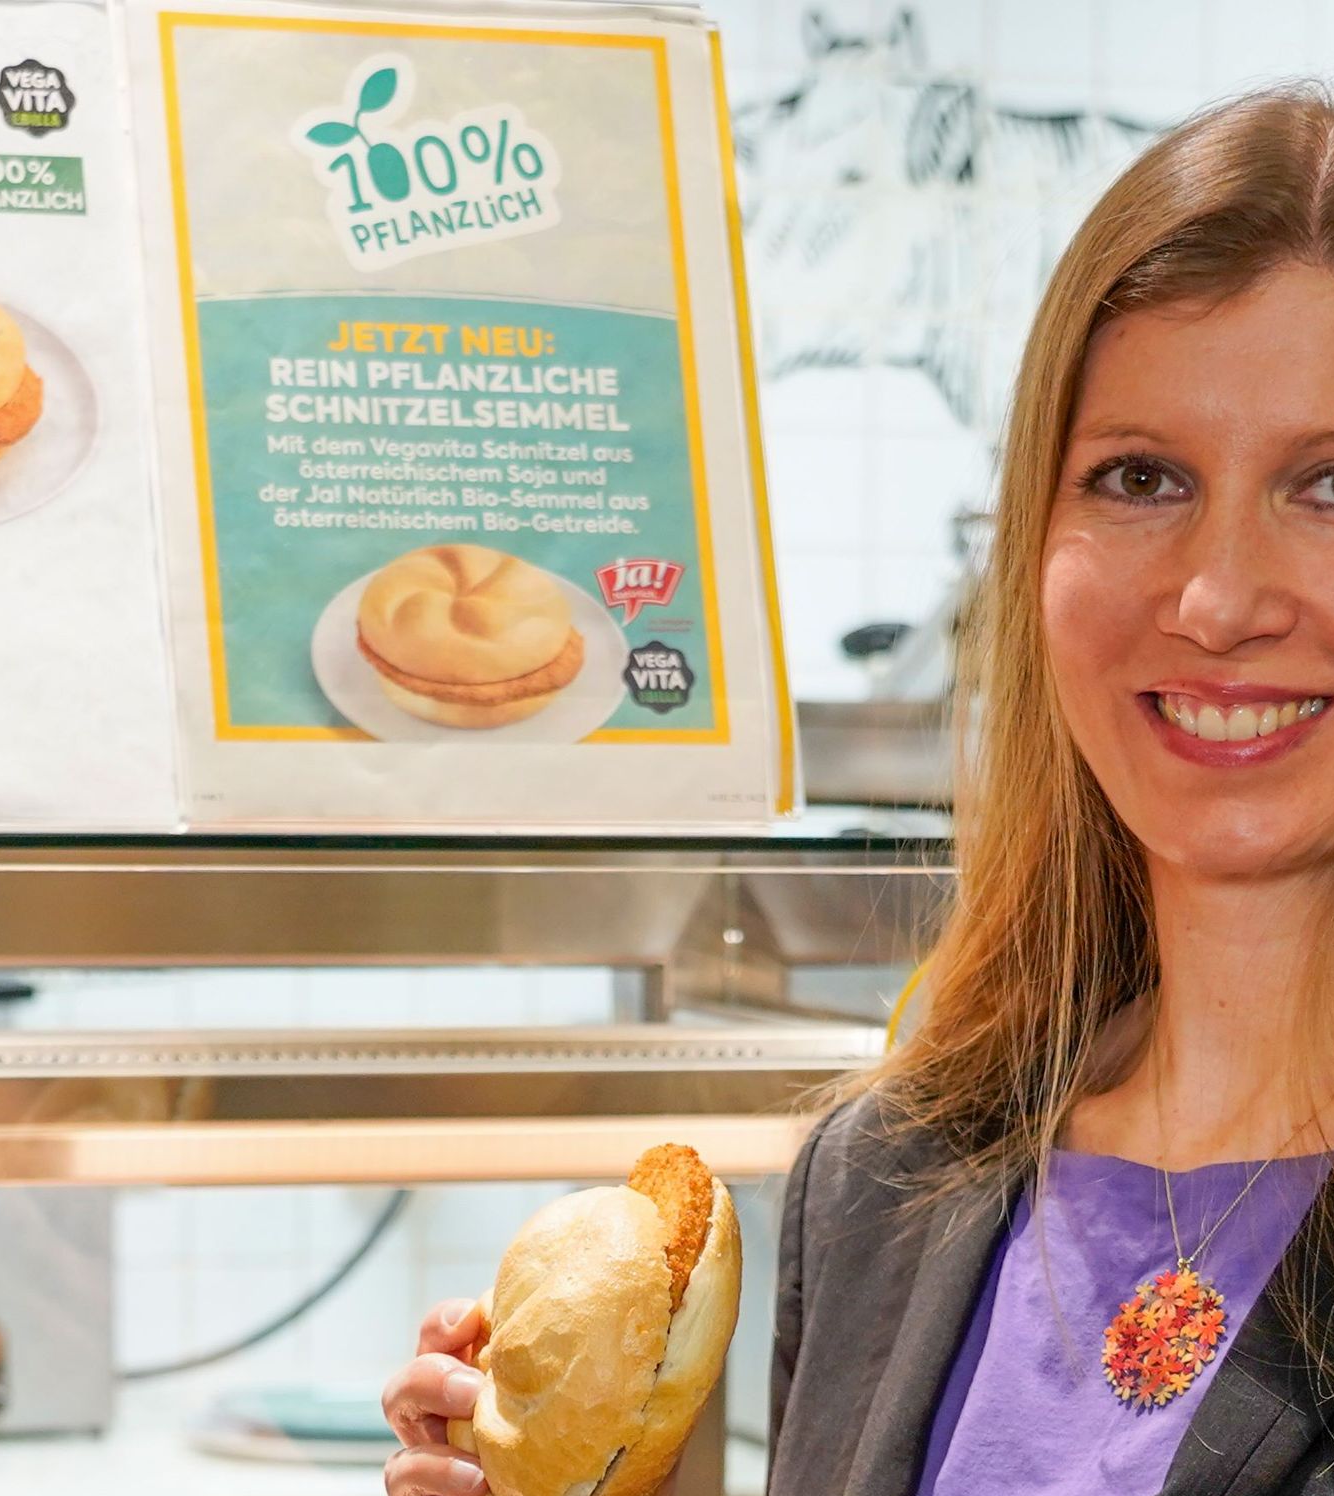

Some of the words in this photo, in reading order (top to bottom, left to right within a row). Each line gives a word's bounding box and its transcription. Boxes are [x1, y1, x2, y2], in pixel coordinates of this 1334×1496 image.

[5, 70, 62, 89] VEGA
[2, 88, 68, 113] VITA
[327, 118, 545, 214] 100%
[327, 320, 451, 354] JETZT
[461, 324, 556, 358] NEU:
[269, 358, 359, 388] REIN
[367, 360, 621, 396] PFLANZLICHE
[266, 393, 631, 432] SCHNITZELSEMMEL
[267, 434, 307, 454] Mit
[310, 436, 366, 456] dem
[369, 437, 478, 461] Vegavita
[481, 439, 589, 461] Schnitzel
[592, 447, 634, 463] aus
[298, 459, 503, 483] österreichischem
[506, 464, 558, 488] Soja
[561, 466, 608, 485] und
[258, 482, 301, 502] der
[305, 483, 342, 503] Ja!
[346, 484, 457, 506] Natürlich
[461, 487, 605, 510] Bio-Semmel
[608, 495, 651, 511] aus
[273, 507, 478, 530] österreichischem
[482, 512, 640, 535] Bio-Getreide.
[632, 652, 682, 669] VEGA
[630, 669, 687, 691] VITA
